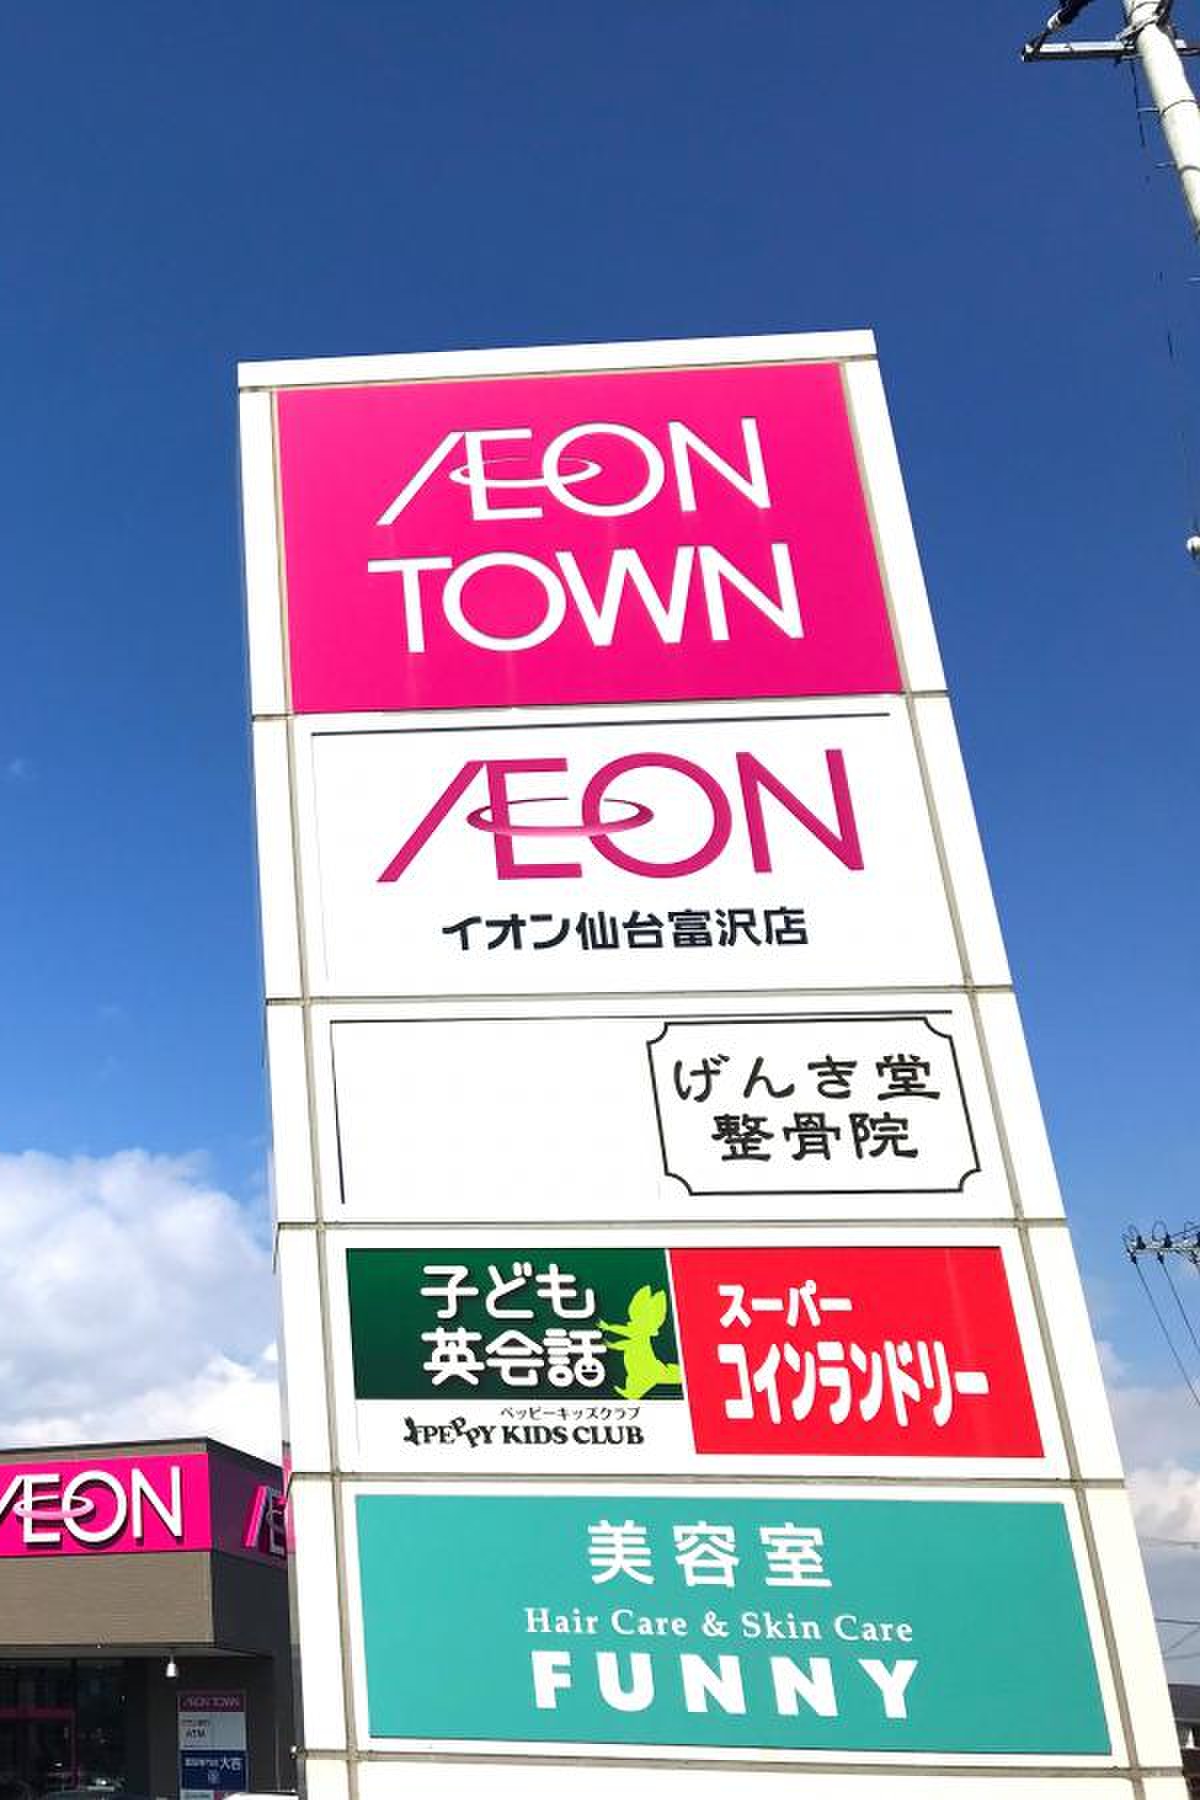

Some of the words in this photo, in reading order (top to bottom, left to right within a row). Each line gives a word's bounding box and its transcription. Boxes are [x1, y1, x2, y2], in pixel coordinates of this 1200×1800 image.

[368, 543, 804, 653] TOWN
[441, 906, 809, 951] イオン仙台富沢店
[673, 1054, 941, 1103] げんき堂
[711, 1112, 919, 1162] 整骨院
[420, 1261, 596, 1319] 子ども
[718, 1279, 852, 1328] スーパー
[420, 1327, 607, 1387] 英会話
[717, 1340, 990, 1427] コインランドリー
[422, 1416, 497, 1448] PEPPY
[503, 1425, 568, 1445] KIDS
[572, 1425, 645, 1445] CLUB
[587, 1519, 833, 1588] 美容室
[524, 1608, 599, 1634] Hair
[611, 1609, 688, 1637] Care
[702, 1613, 730, 1638] &
[742, 1612, 822, 1641] Skin
[834, 1615, 914, 1642] Care
[530, 1650, 919, 1719] FUNNY
